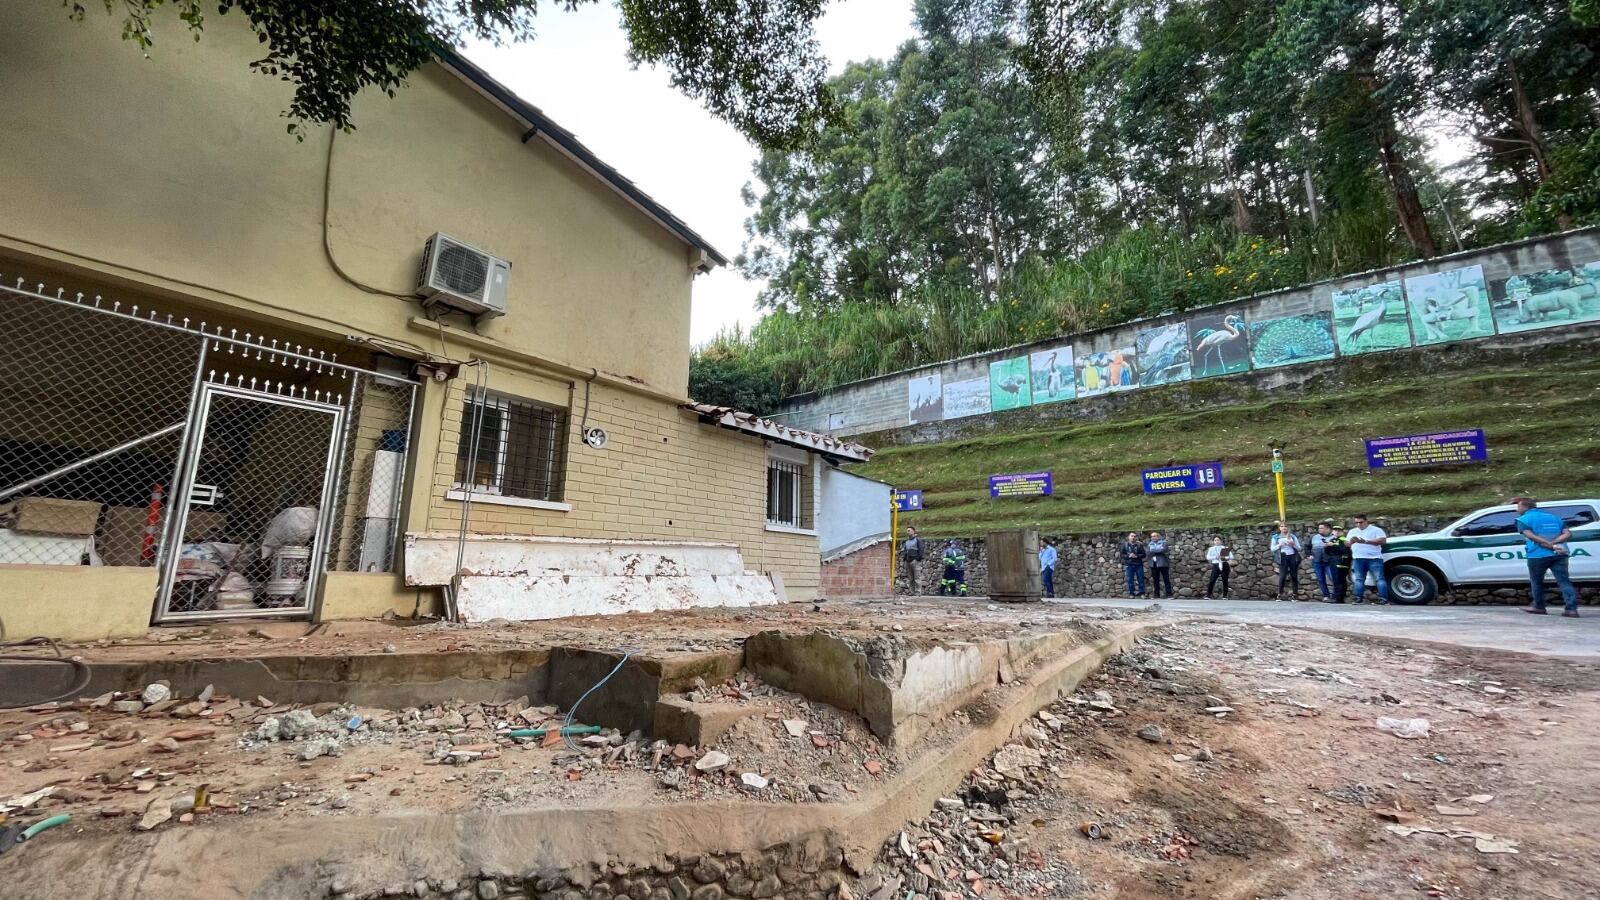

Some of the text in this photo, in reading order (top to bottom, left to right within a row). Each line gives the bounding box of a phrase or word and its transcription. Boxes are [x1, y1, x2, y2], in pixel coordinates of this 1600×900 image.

[1145, 470, 1181, 479] PARQUEAR
[1151, 480, 1186, 490] REVERSA
[1477, 548, 1592, 561] POLA
